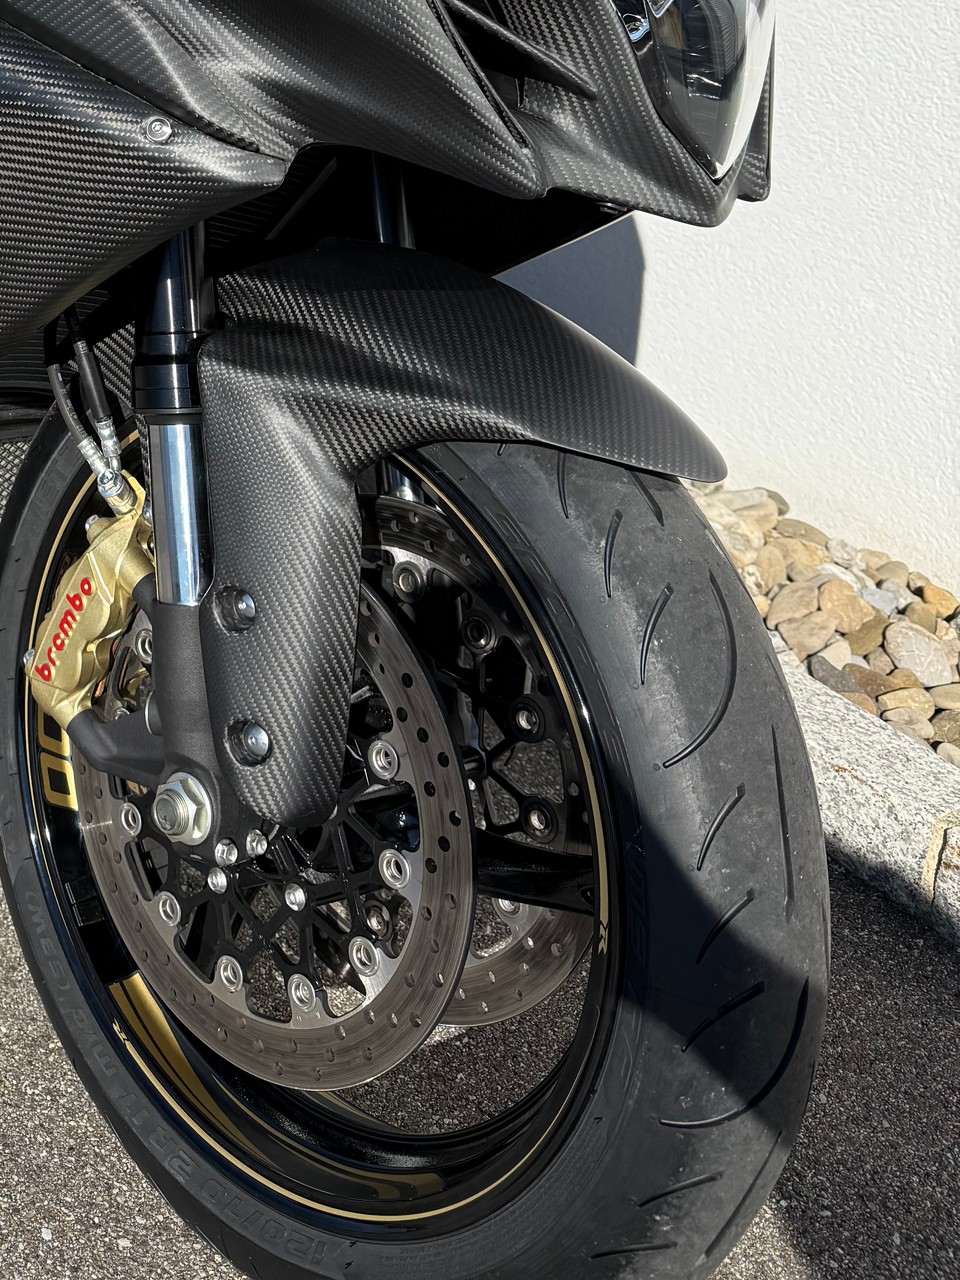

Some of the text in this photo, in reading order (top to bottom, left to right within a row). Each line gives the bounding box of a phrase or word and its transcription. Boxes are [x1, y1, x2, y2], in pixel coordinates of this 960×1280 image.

[35, 577, 93, 682] brembo
[70, 1004, 119, 1079] M/C
[195, 1174, 329, 1266] 120/70
